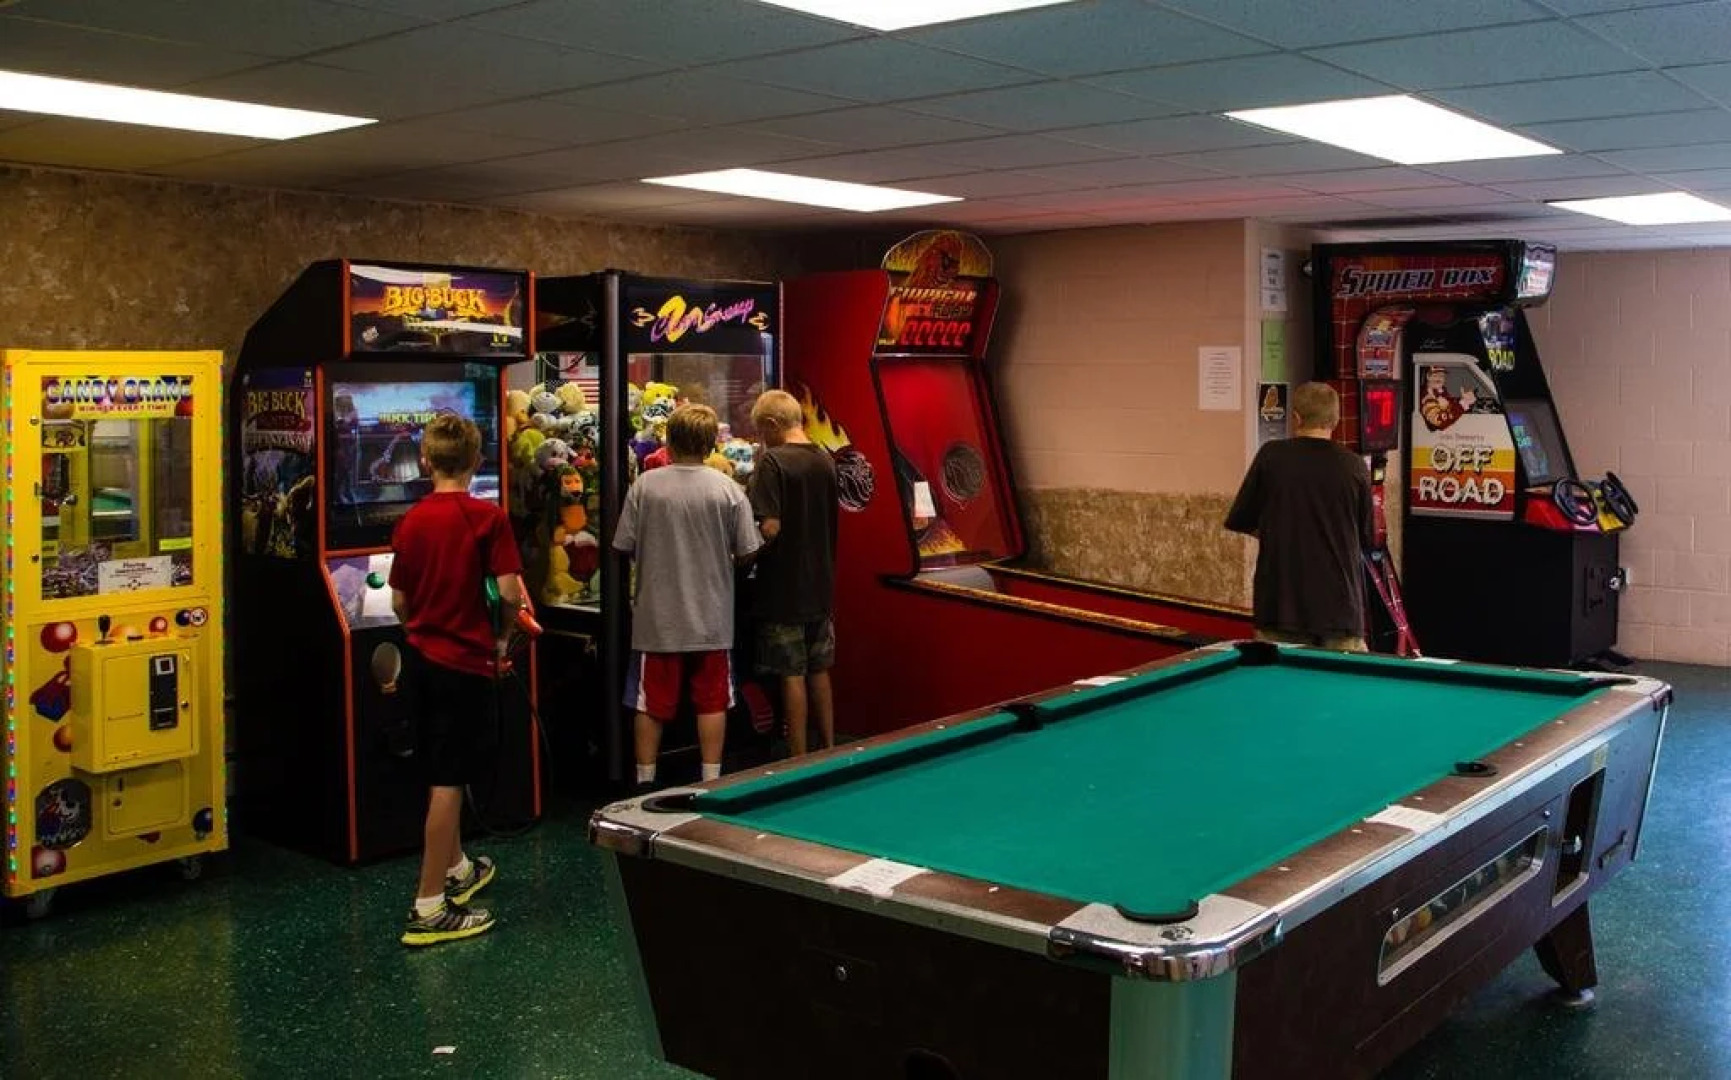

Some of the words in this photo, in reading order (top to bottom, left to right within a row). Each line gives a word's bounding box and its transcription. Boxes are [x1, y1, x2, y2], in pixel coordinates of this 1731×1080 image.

[384, 286, 425, 315] BIG
[426, 286, 488, 317] BUCK
[46, 379, 119, 404] CANDY
[124, 379, 192, 402] CRANE
[246, 391, 270, 415] BIG
[271, 391, 305, 419] BUCK
[1431, 444, 1495, 473] OFF
[1418, 475, 1505, 505] ROAD
